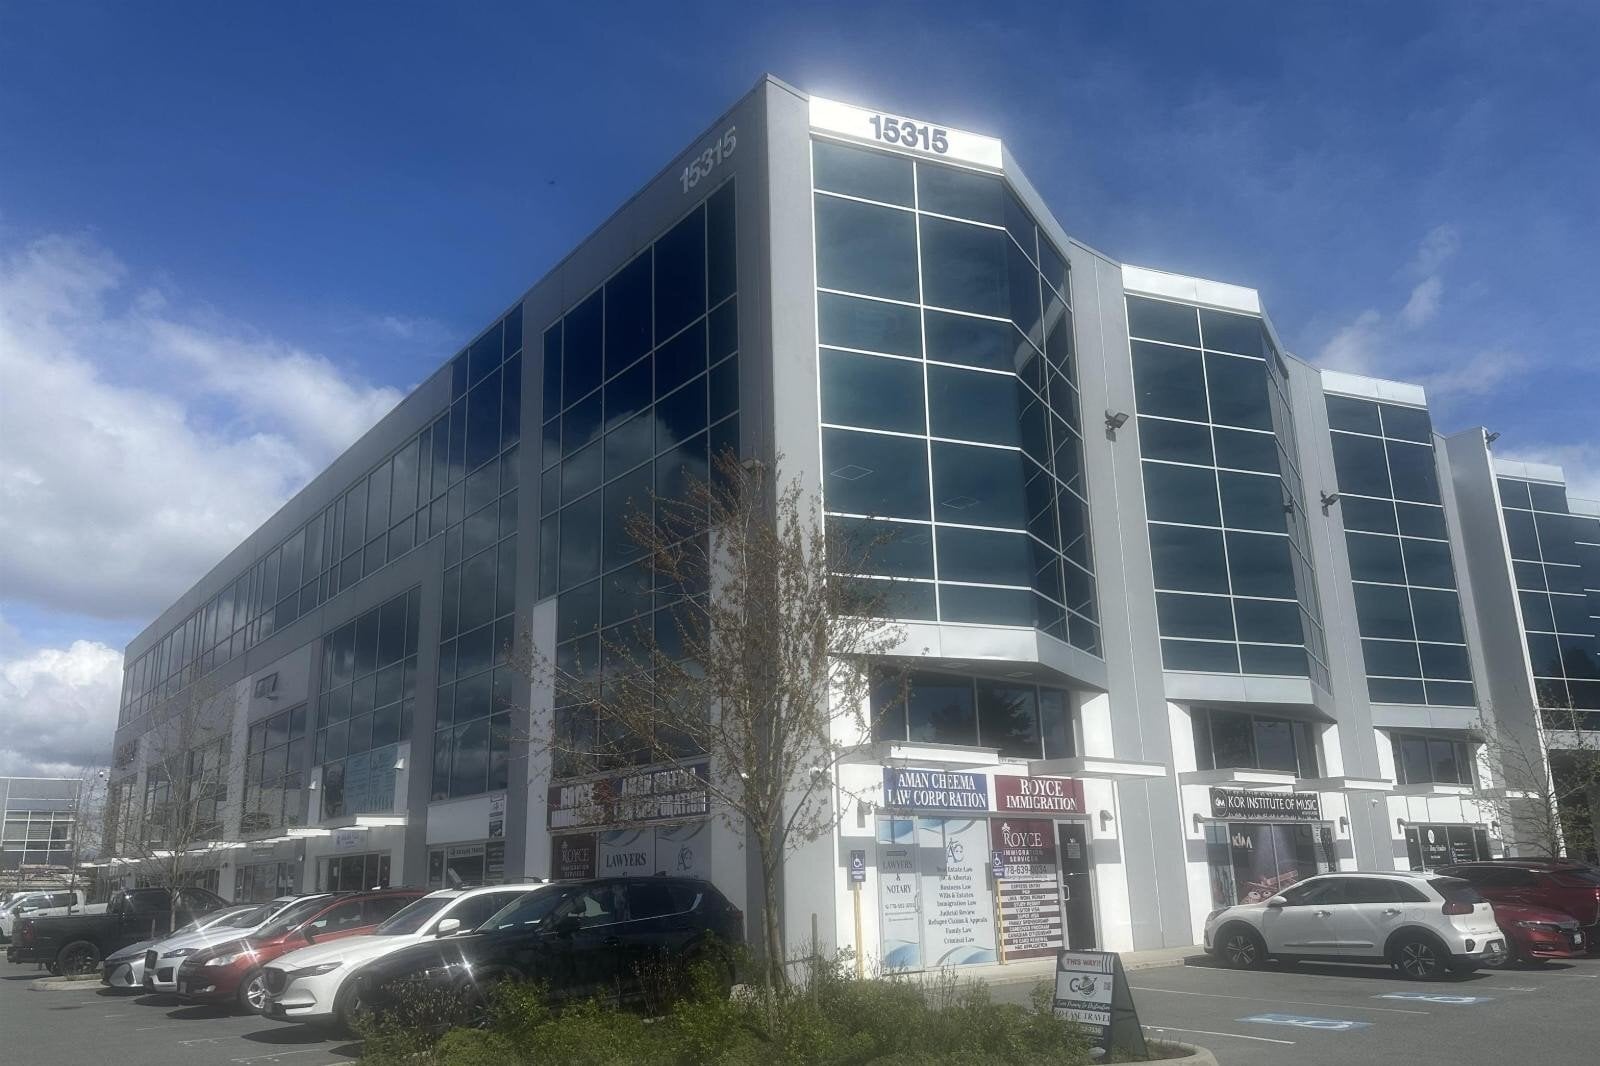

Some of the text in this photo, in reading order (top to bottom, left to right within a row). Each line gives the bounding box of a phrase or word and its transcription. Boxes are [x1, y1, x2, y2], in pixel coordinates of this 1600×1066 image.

[869, 114, 949, 154] 15315
[679, 126, 737, 195] 15315
[898, 772, 976, 790] AMAN CHEEMA
[1019, 779, 1063, 797] ROYCE
[887, 789, 986, 808] LAW CORPORATION
[1006, 795, 1077, 811] IMMIGRATION
[1227, 796, 1317, 811] KOR INSTITUTE OF MUSIC
[1002, 829, 1043, 848] ROYCE
[606, 852, 647, 868] LAWYERS
[882, 860, 913, 870] LAWYERS
[886, 884, 912, 894] NOTARY
[1066, 958, 1082, 966] THIS
